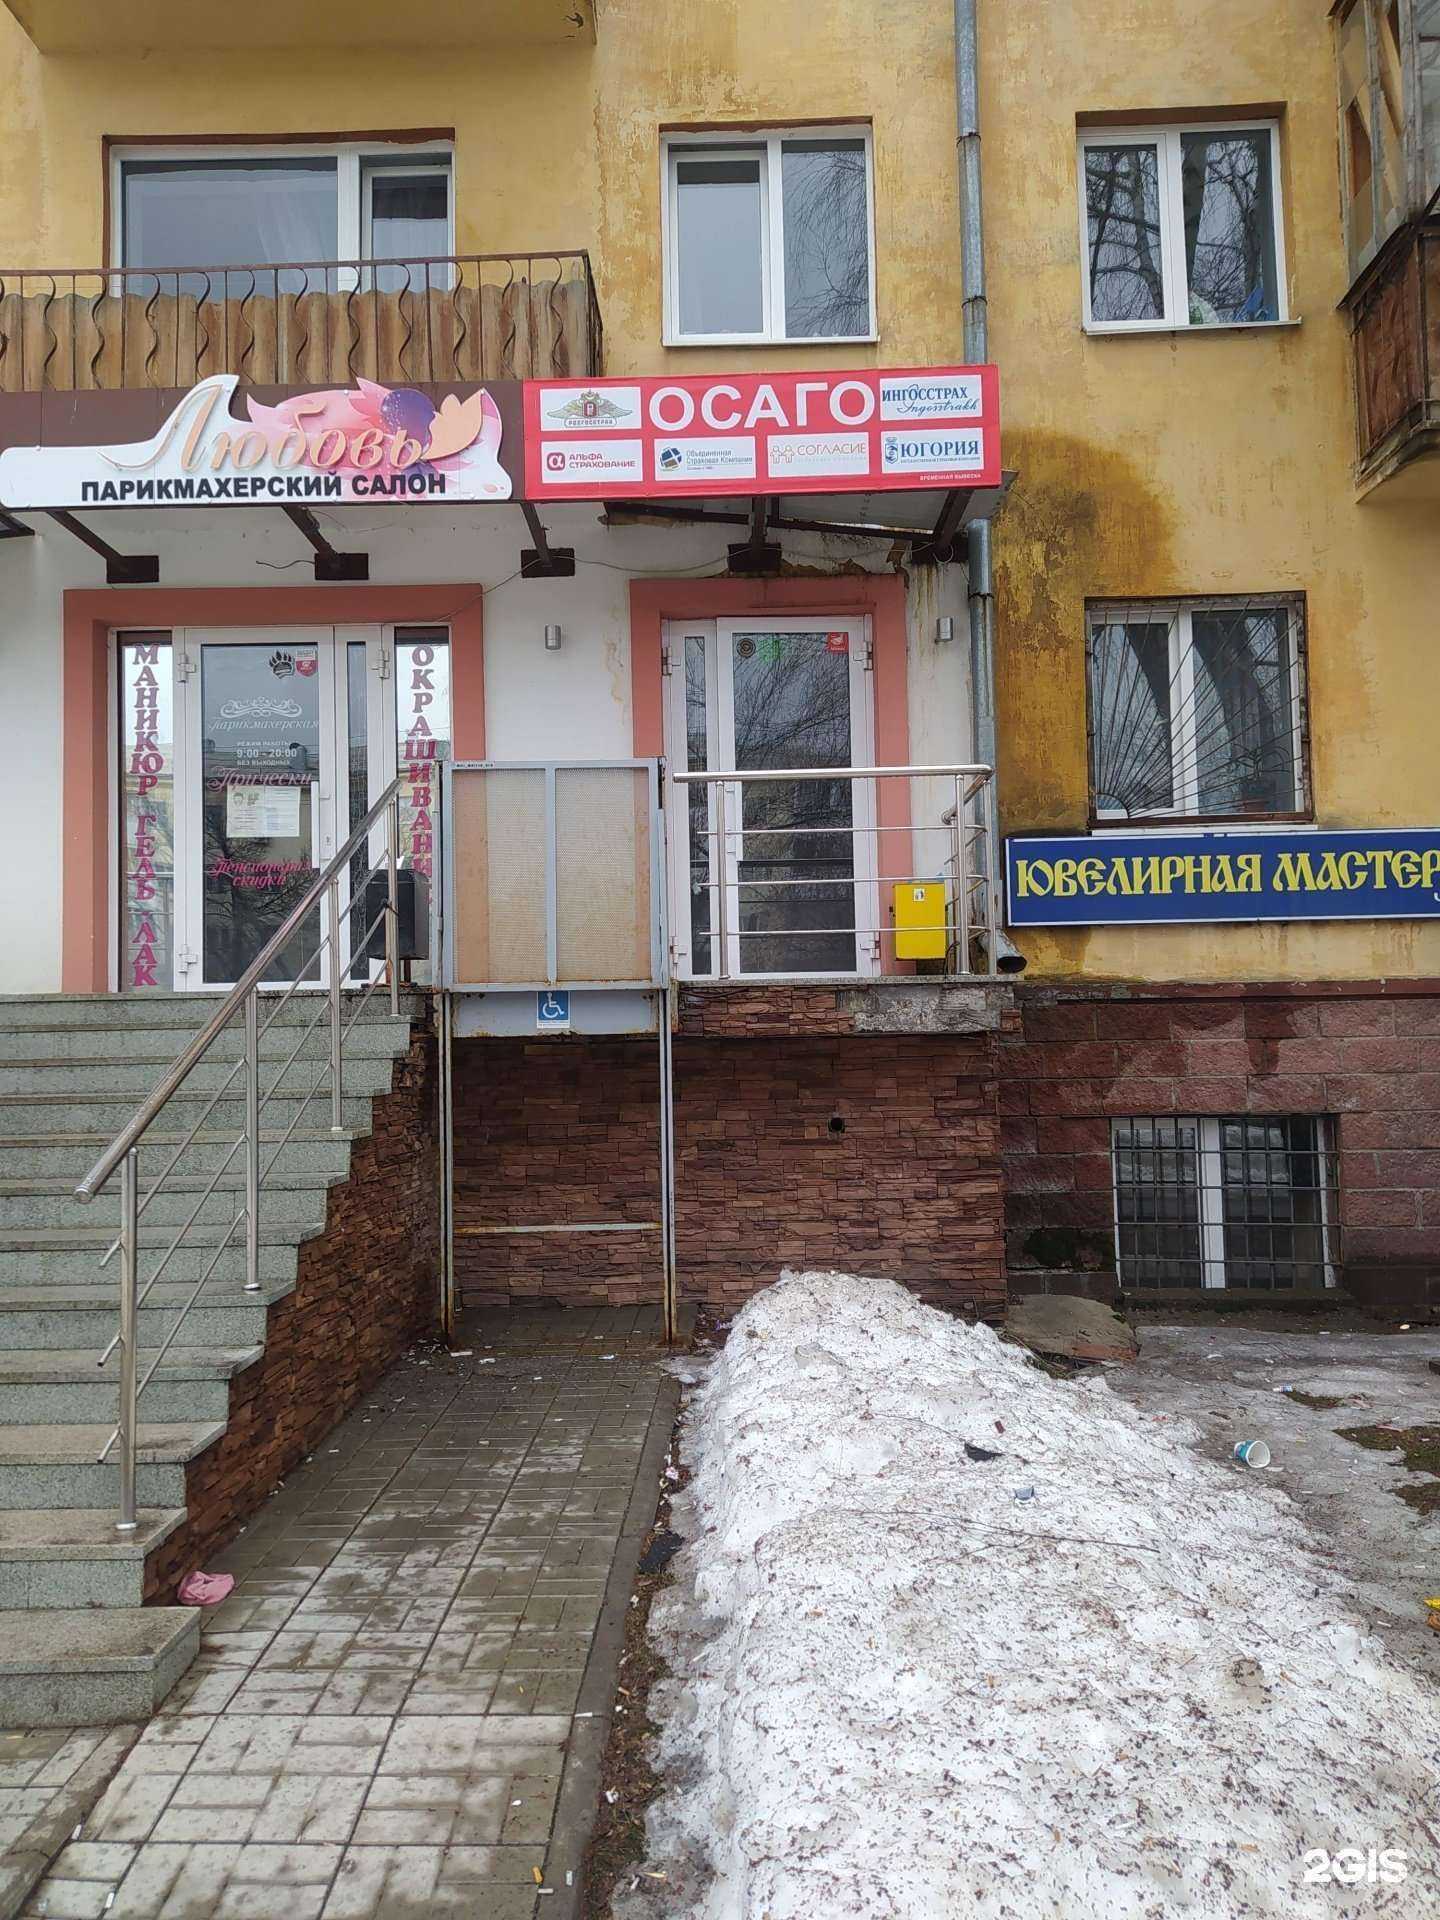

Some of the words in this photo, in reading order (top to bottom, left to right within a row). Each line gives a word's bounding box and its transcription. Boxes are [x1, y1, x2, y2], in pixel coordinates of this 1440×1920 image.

[882, 384, 968, 401] ИНГОССТРАХ
[648, 382, 875, 432] ОСАГО
[97, 384, 424, 472] Любовь
[797, 443, 866, 456] СОГЛАСИЕ
[900, 440, 979, 458] ЮГОРИЯ
[569, 461, 636, 469] СТРАХОВАНИЕ
[81, 473, 342, 501] ПАРИКМАХЕРСКИЙ
[351, 474, 446, 495] САЛОН
[130, 643, 164, 796] МАНИКЮР
[1016, 854, 1262, 897] ЮВЕЛИРНАЯ
